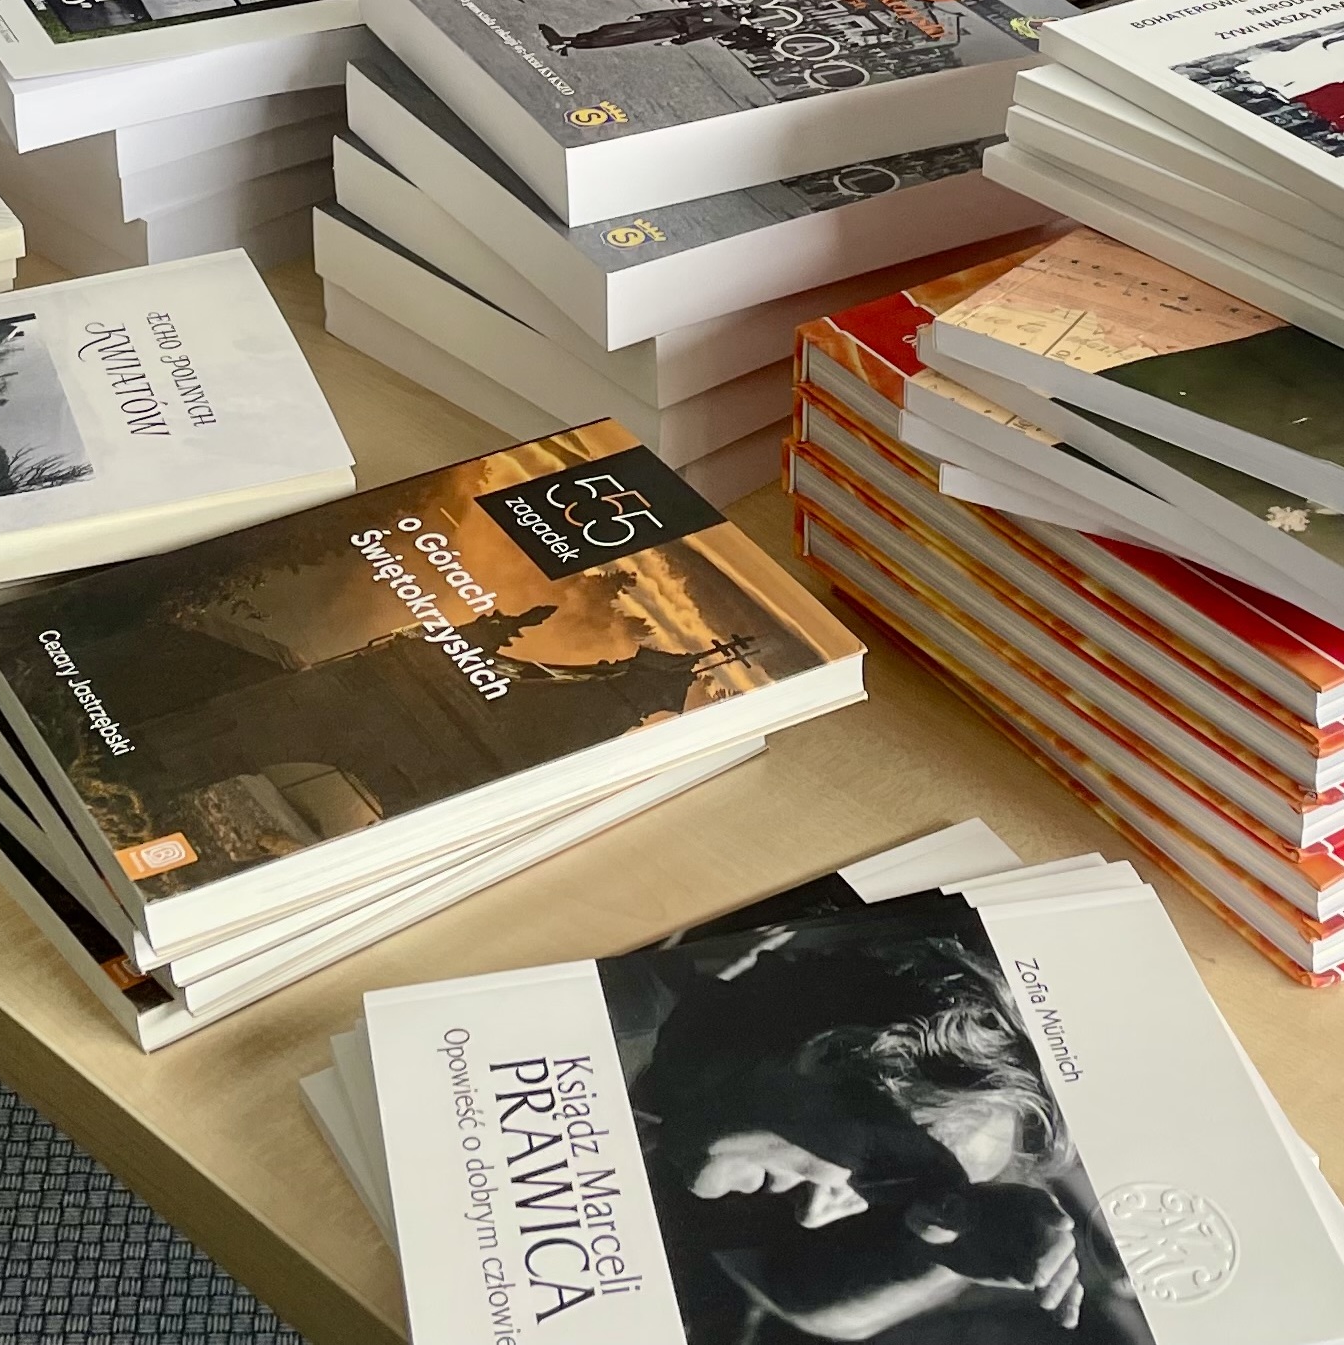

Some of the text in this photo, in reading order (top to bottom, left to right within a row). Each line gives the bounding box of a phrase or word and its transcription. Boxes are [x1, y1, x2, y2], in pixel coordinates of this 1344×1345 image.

[1214, 23, 1260, 41] ŻYWI
[1259, 9, 1313, 33] NASZĄ
[76, 319, 172, 437] KWIATÓW
[145, 309, 219, 430] ECHO POLNYCH
[396, 515, 499, 616] o Górach
[502, 491, 584, 565] zagadek
[543, 473, 664, 549] 555
[348, 524, 511, 704] Świętokrzyskich
[36, 627, 136, 759] Cezary Jastrzębski
[1014, 955, 1084, 1085] Zofia Münnich
[438, 1026, 479, 1130] Opowieść
[464, 1153, 499, 1251] dobrym
[488, 1057, 598, 1328] PRAWICA
[553, 1052, 642, 1298] Ksiądz Marceli
